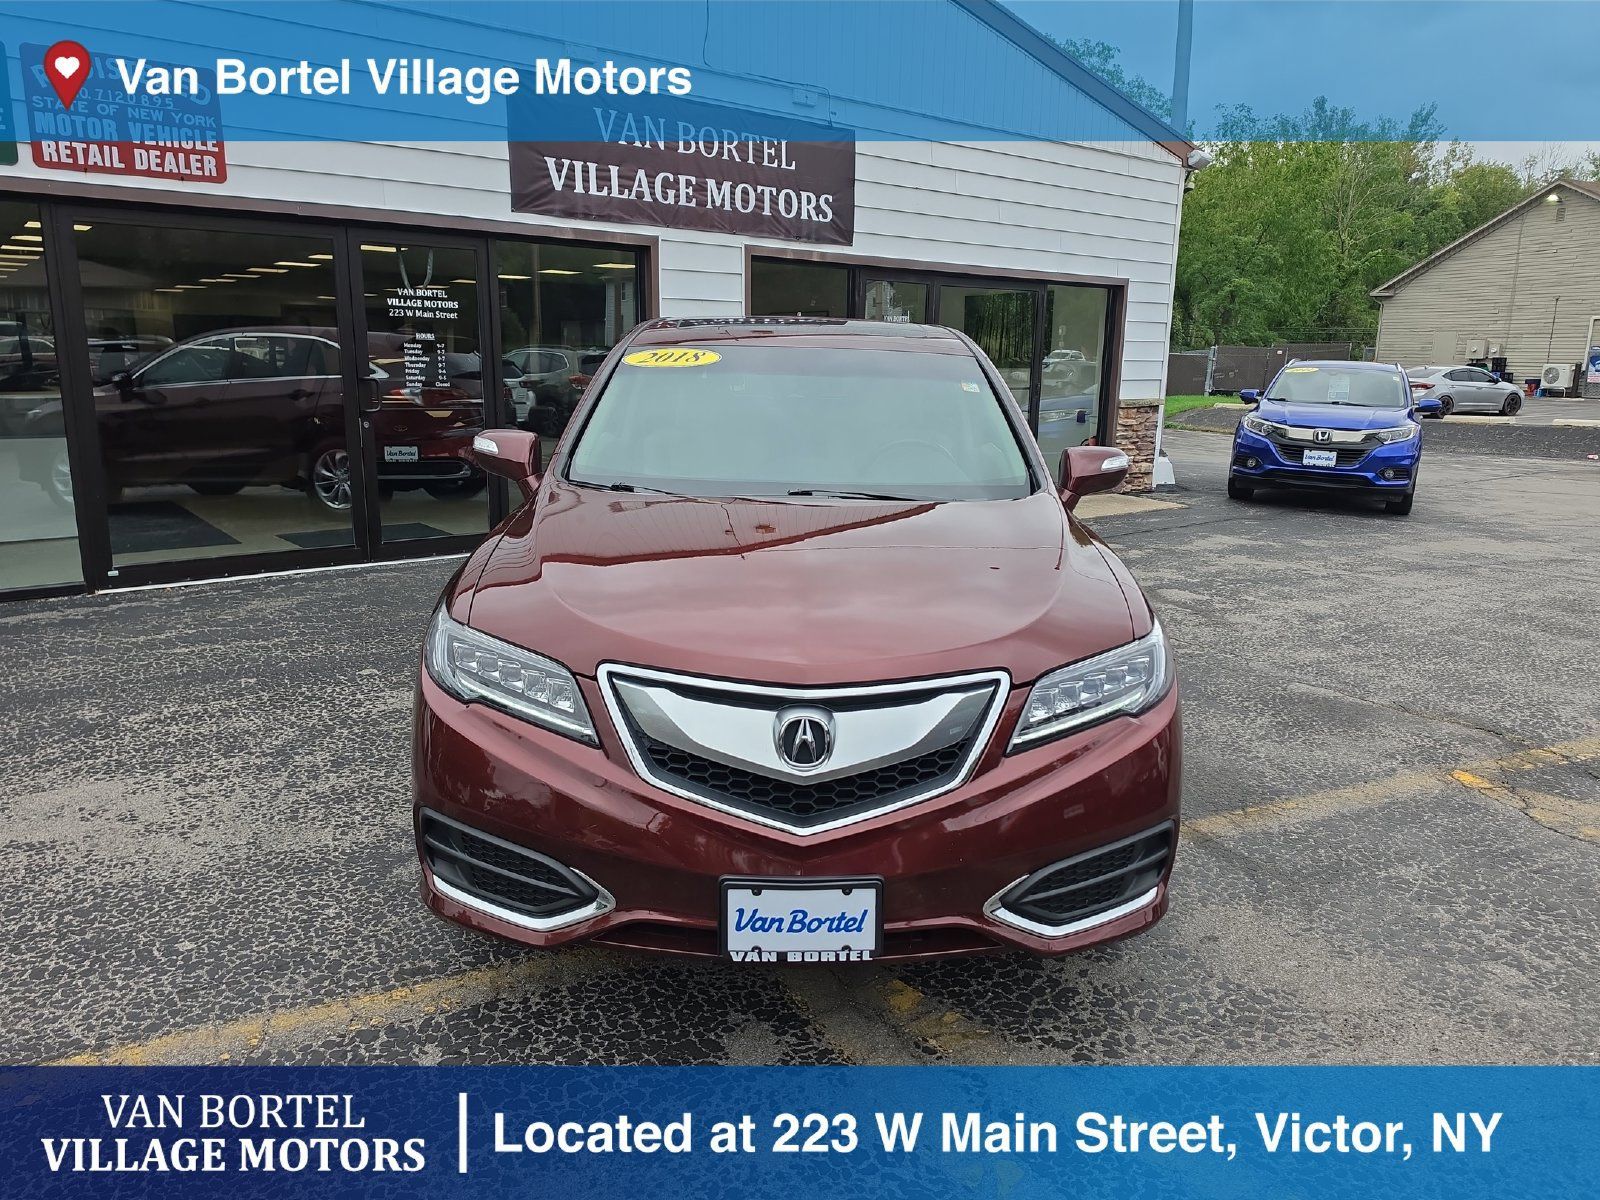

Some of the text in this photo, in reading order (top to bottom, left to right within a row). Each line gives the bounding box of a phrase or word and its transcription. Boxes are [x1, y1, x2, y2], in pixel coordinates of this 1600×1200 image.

[96, 103, 119, 116] OF
[127, 106, 163, 122] NEW
[171, 112, 216, 129] YORK
[34, 111, 119, 142] MOTOR
[127, 121, 219, 152] VEHICLE
[593, 107, 796, 170] VAN BORTEL
[41, 140, 218, 177] RETAIL DEALER
[543, 156, 834, 223] VILLAGE MOTORS
[387, 298, 459, 309] VILLAGE MOTORS
[397, 288, 448, 298] VAN BORTEL
[389, 308, 458, 319] 223 W Main Street
[637, 352, 706, 363] 2018
[735, 908, 869, 933] Van Bortel
[730, 950, 873, 962] VAN BORTEL
